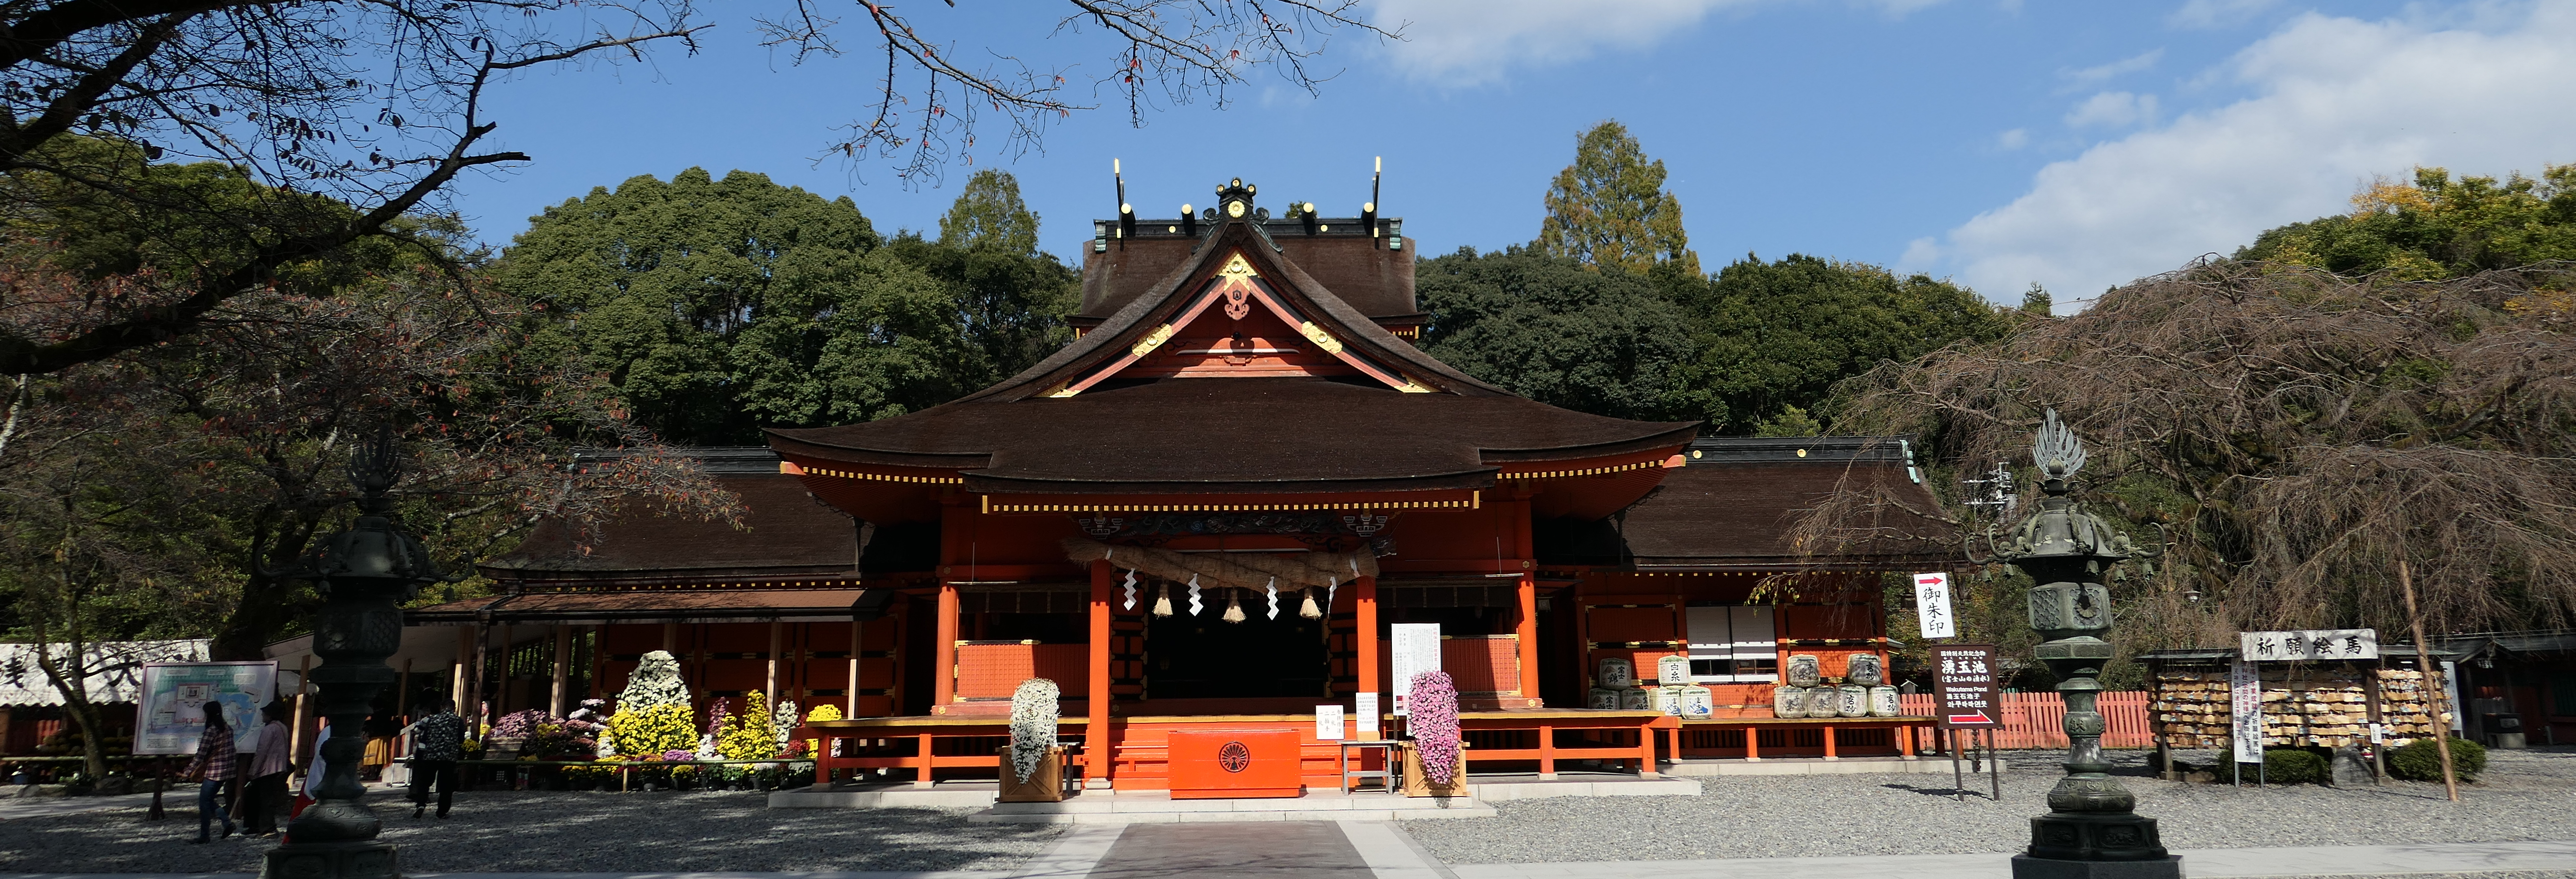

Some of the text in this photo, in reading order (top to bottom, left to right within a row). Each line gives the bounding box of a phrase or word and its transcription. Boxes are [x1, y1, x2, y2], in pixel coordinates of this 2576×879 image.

[1922, 586, 1944, 635] 御朱印
[2256, 635, 2363, 656] 祈願絵馬
[1670, 663, 1680, 682] 白糸
[1941, 659, 1988, 675] 湧玉池
[1318, 712, 1324, 726] 一礼
[1330, 711, 1336, 726] 二礼
